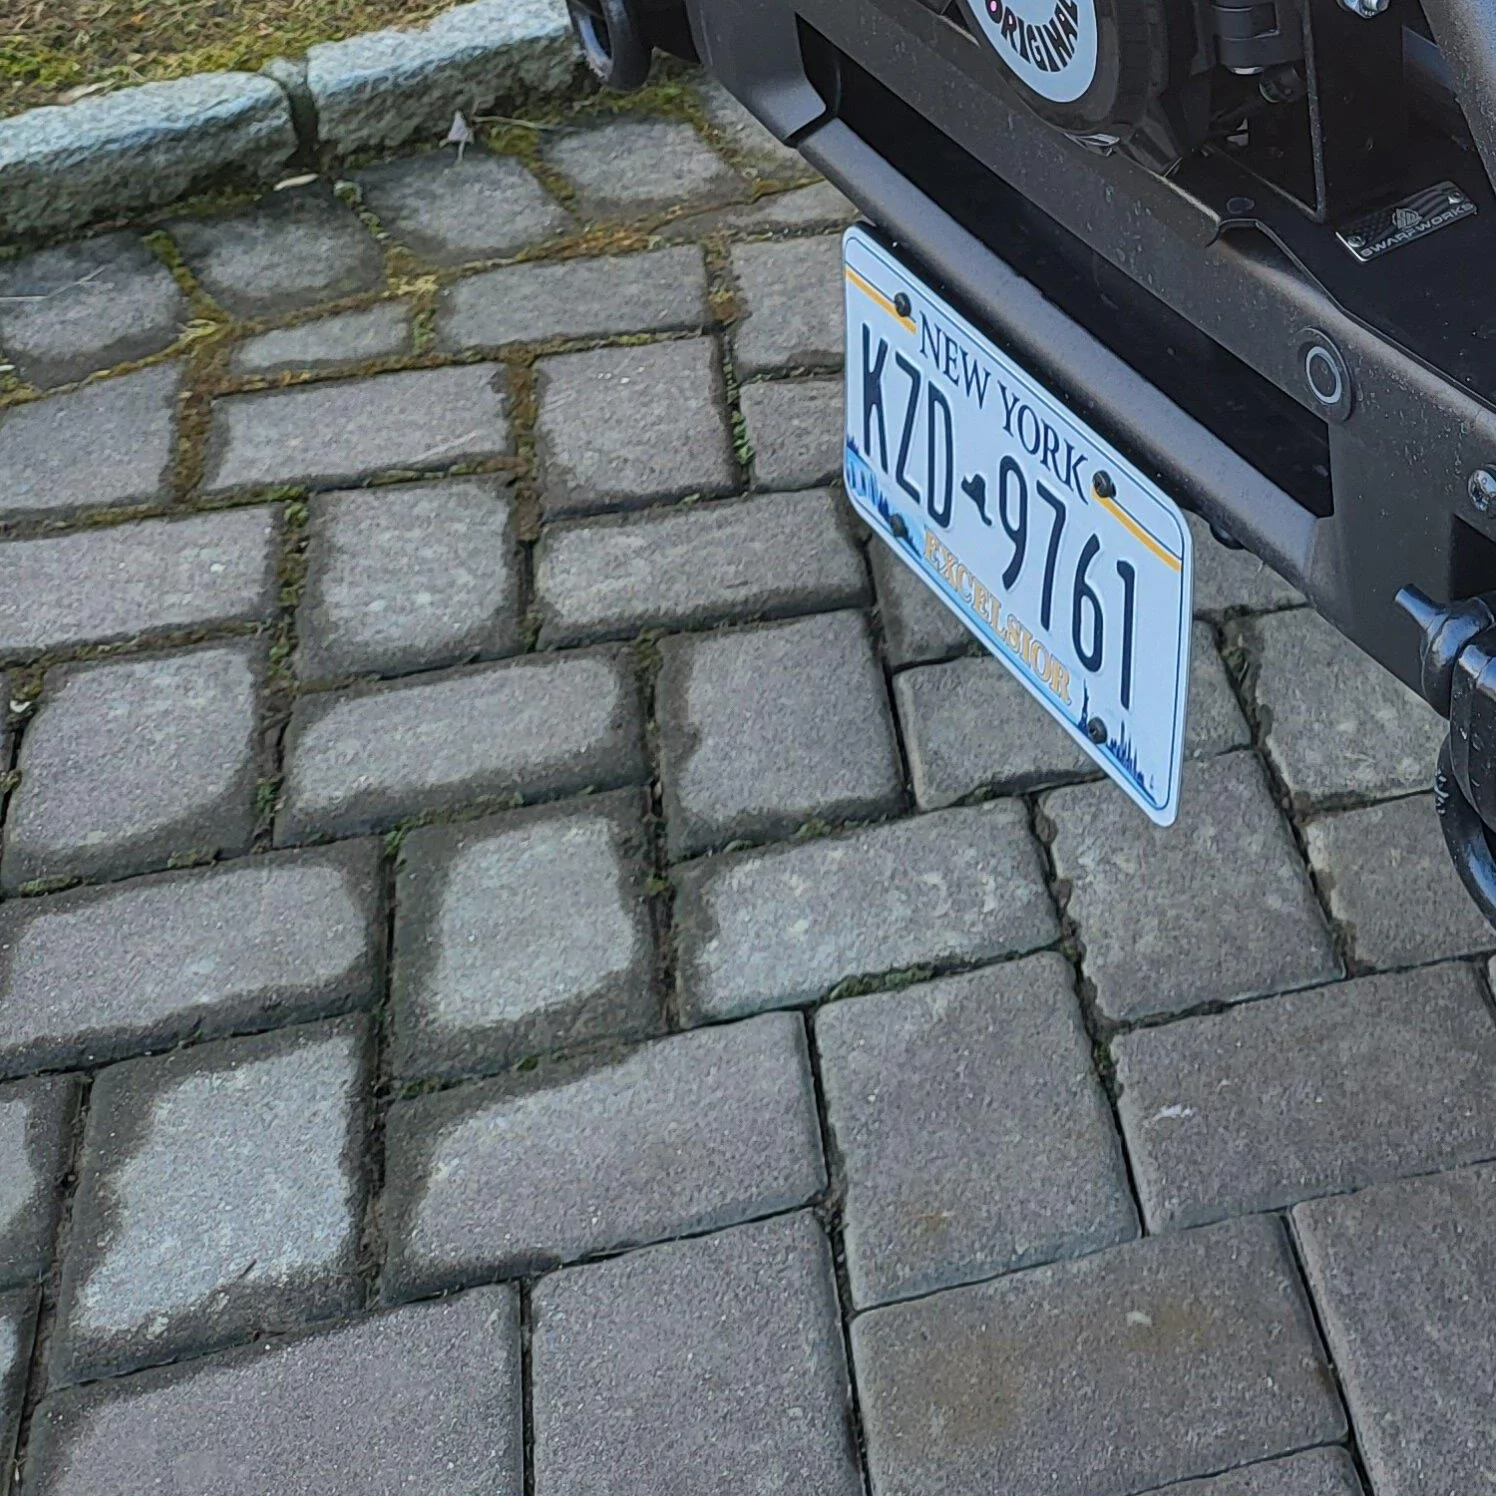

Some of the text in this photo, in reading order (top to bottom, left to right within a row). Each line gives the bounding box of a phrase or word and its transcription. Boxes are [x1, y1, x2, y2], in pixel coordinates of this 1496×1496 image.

[918, 311, 1090, 506] NEW YORK
[922, 529, 1073, 706] EXCELSIOR
